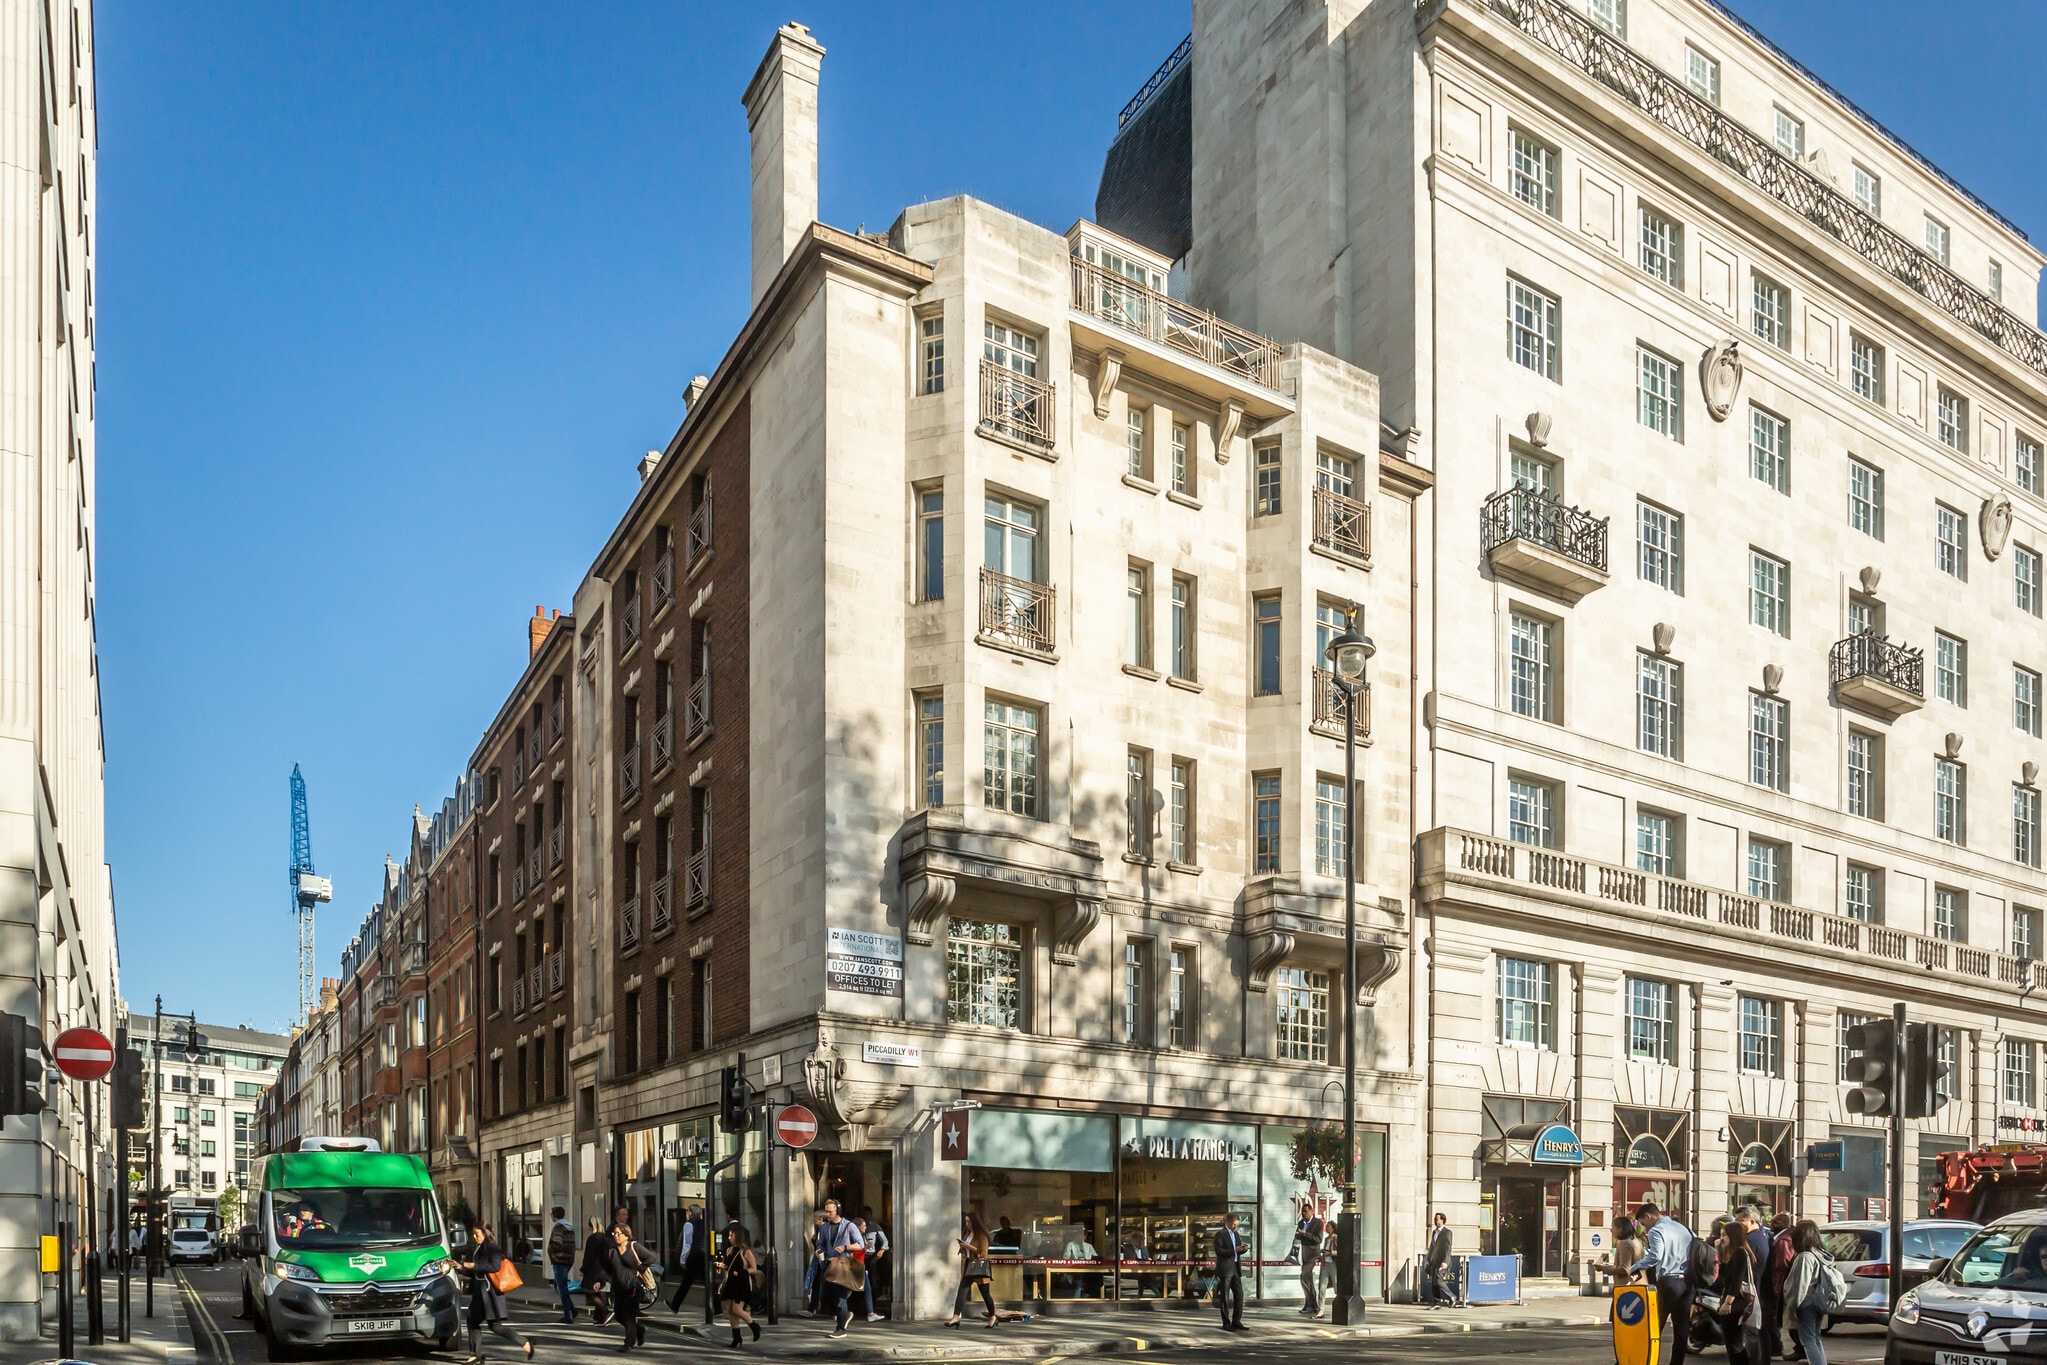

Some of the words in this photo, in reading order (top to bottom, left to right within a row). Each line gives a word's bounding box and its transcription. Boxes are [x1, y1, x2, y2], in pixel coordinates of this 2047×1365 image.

[841, 933, 856, 942] IAN
[858, 935, 883, 945] SCOTT
[832, 942, 883, 953] INTERNATIONAL
[832, 961, 856, 972] 0207
[858, 965, 876, 975] 493
[878, 967, 900, 978] 9911
[835, 974, 868, 986] OFFICES
[870, 978, 880, 987] TO
[882, 980, 896, 989] LET
[868, 1045, 906, 1055] PICCADILLY
[1148, 1137, 1178, 1159] PRET
[1193, 1139, 1239, 1162] MANGER
[1543, 1140, 1579, 1153] HENRY'S
[1479, 1272, 1506, 1281] HENRY'S
[354, 1322, 375, 1330] SK18
[377, 1321, 394, 1329] JHF
